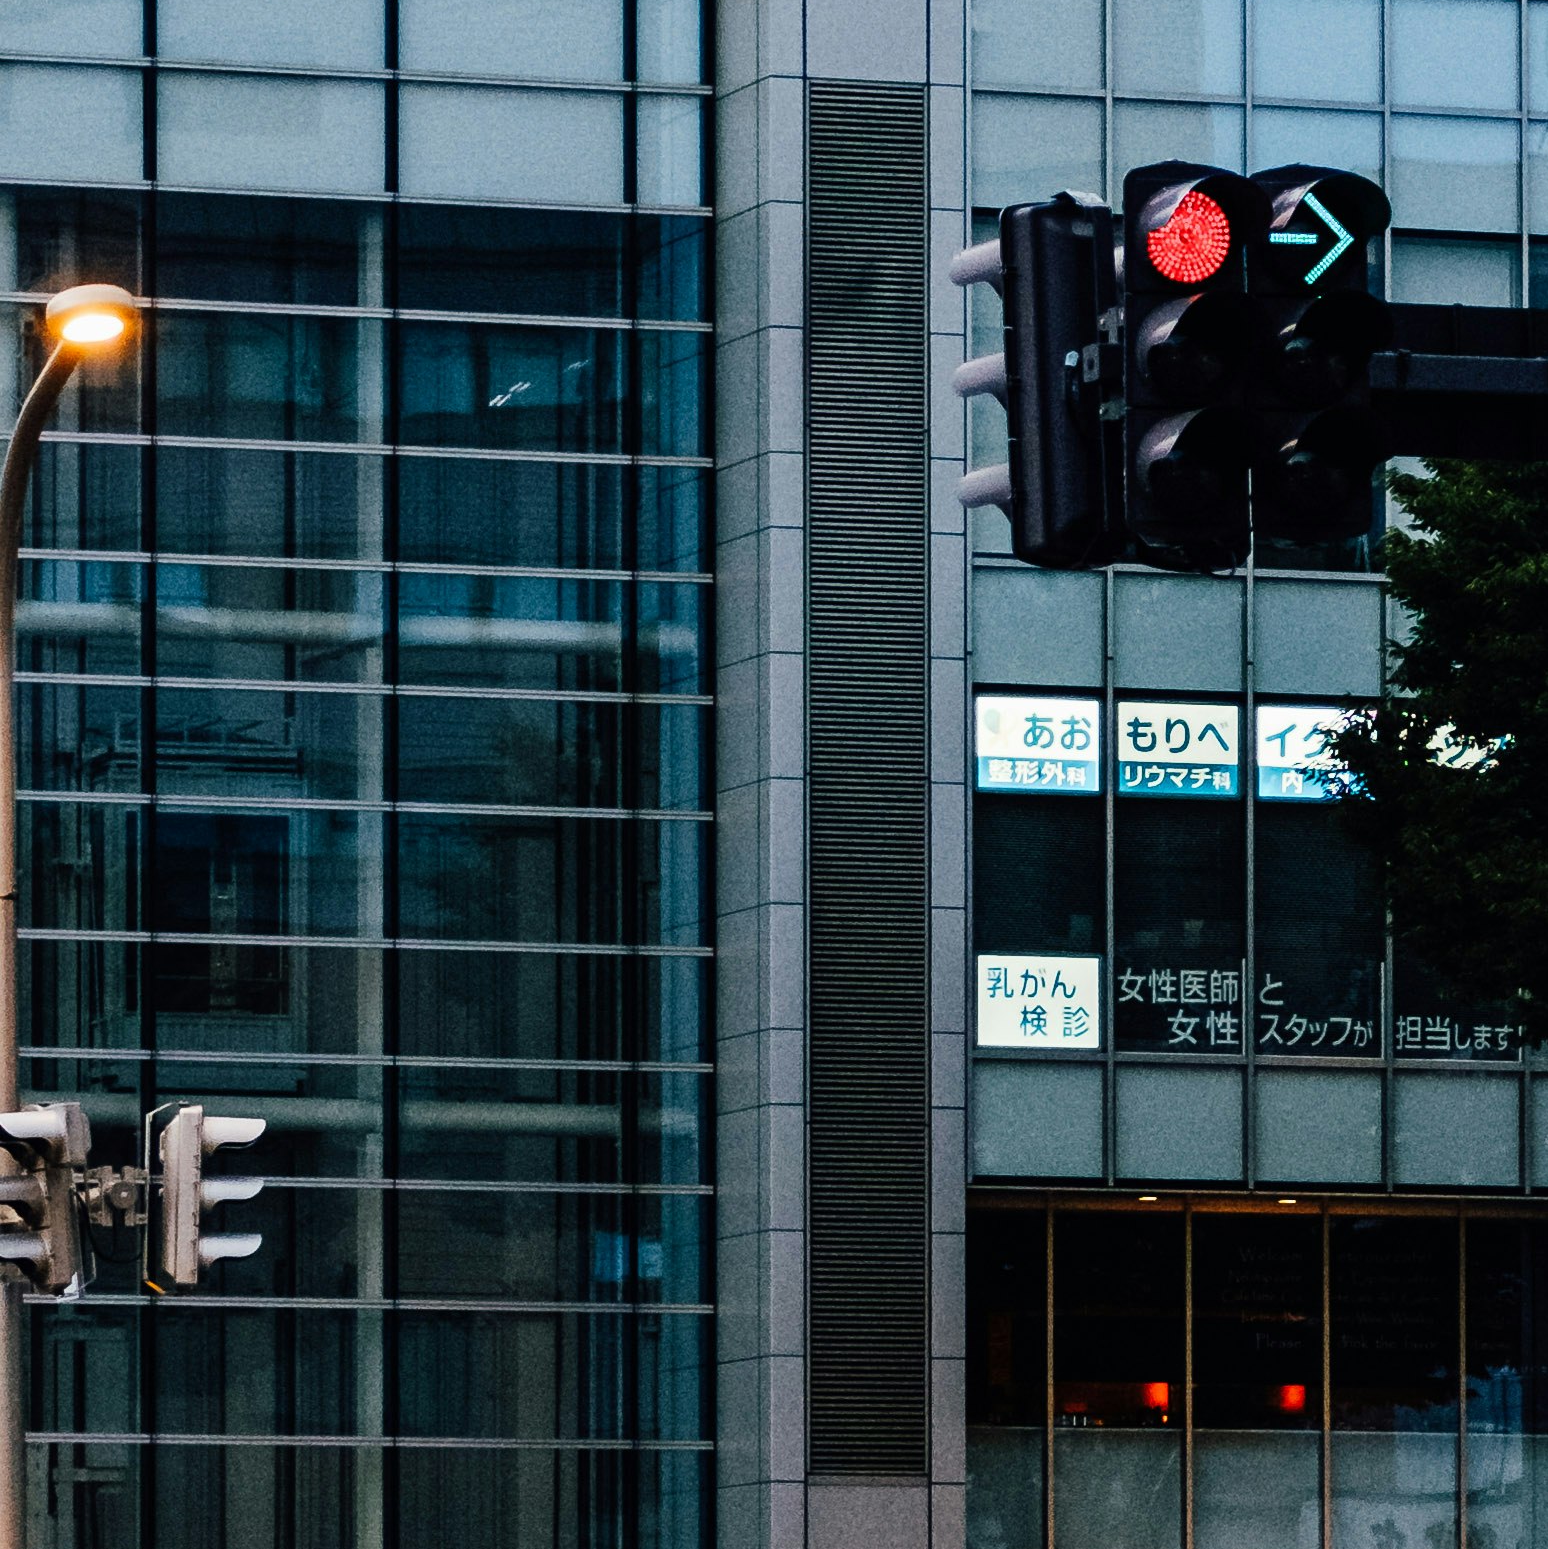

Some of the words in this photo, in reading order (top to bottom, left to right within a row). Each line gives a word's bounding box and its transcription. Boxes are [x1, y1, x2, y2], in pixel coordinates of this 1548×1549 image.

[988, 758, 1086, 787] 整形外科
[1124, 765, 1231, 790] リウマチ科
[987, 967, 1077, 999] 乳がん
[1019, 1004, 1090, 1038] 検診
